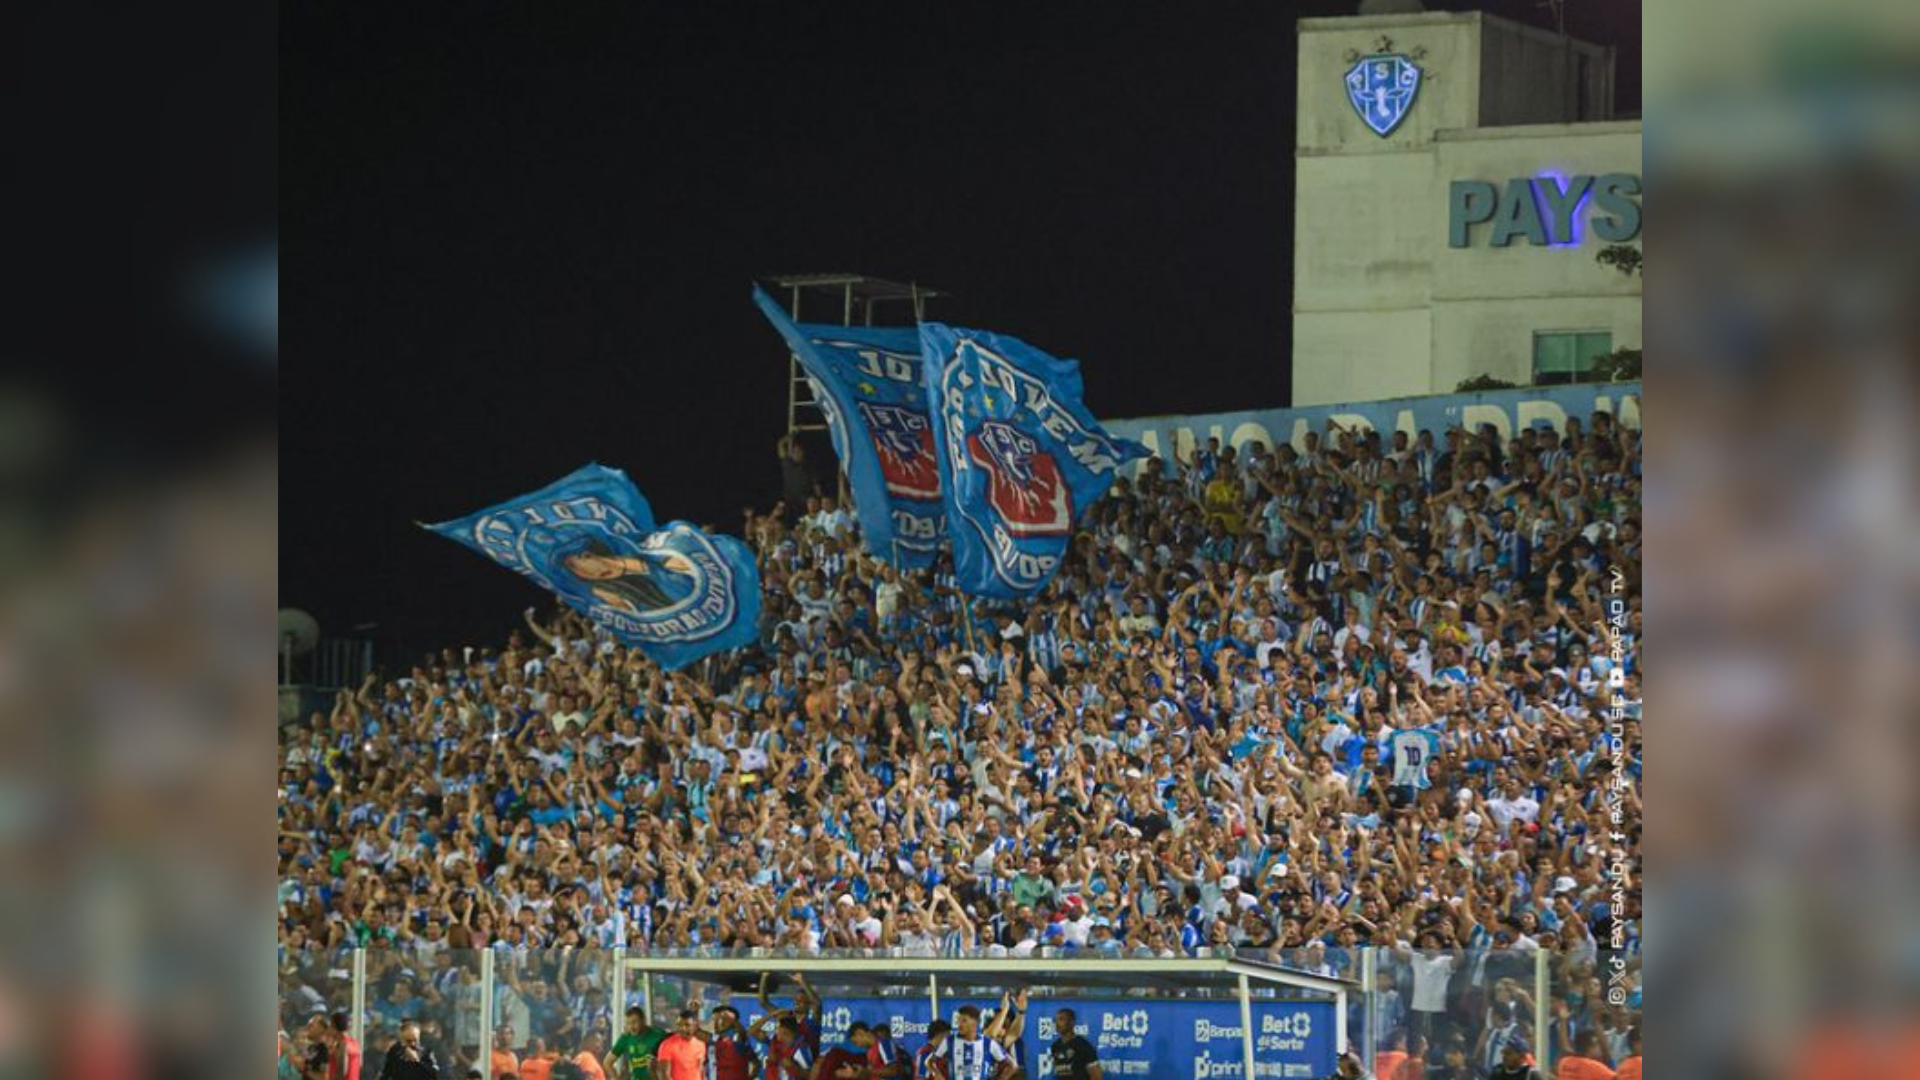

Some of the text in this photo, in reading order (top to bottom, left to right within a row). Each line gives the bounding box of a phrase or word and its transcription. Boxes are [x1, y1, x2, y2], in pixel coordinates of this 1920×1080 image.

[1449, 173, 1642, 248] PAYS
[979, 358, 1116, 475] JOVEM
[1404, 746, 1421, 766] 10
[1103, 1012, 1129, 1031] Bet
[1263, 1014, 1291, 1033] Bet
